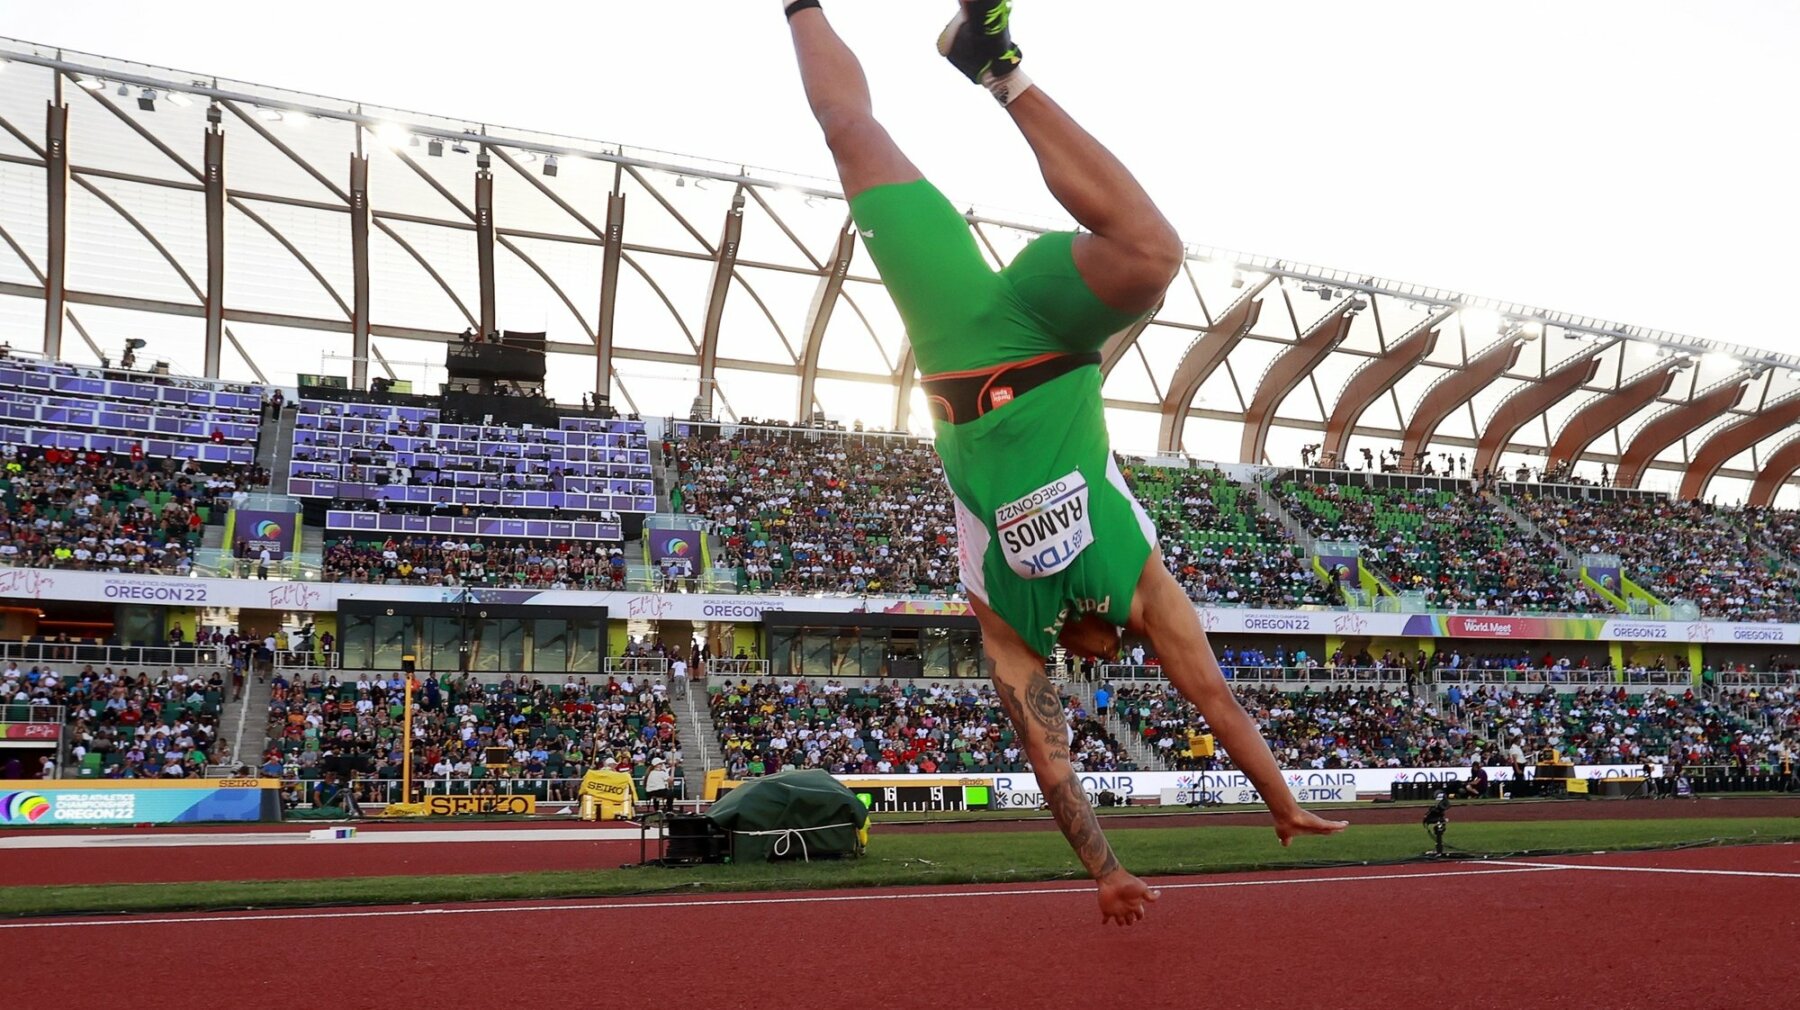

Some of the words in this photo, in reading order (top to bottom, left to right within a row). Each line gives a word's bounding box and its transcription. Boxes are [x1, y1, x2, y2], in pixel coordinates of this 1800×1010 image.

[998, 481, 1067, 522] OREGON22
[1004, 496, 1083, 554] RAMOS
[1020, 539, 1075, 576] TDK
[219, 779, 259, 787] SEIKO
[587, 781, 624, 795] SEIKO
[884, 787, 895, 801] 16
[930, 787, 941, 800] 15
[1309, 788, 1342, 800] TDK
[431, 796, 529, 815] SEIKO
